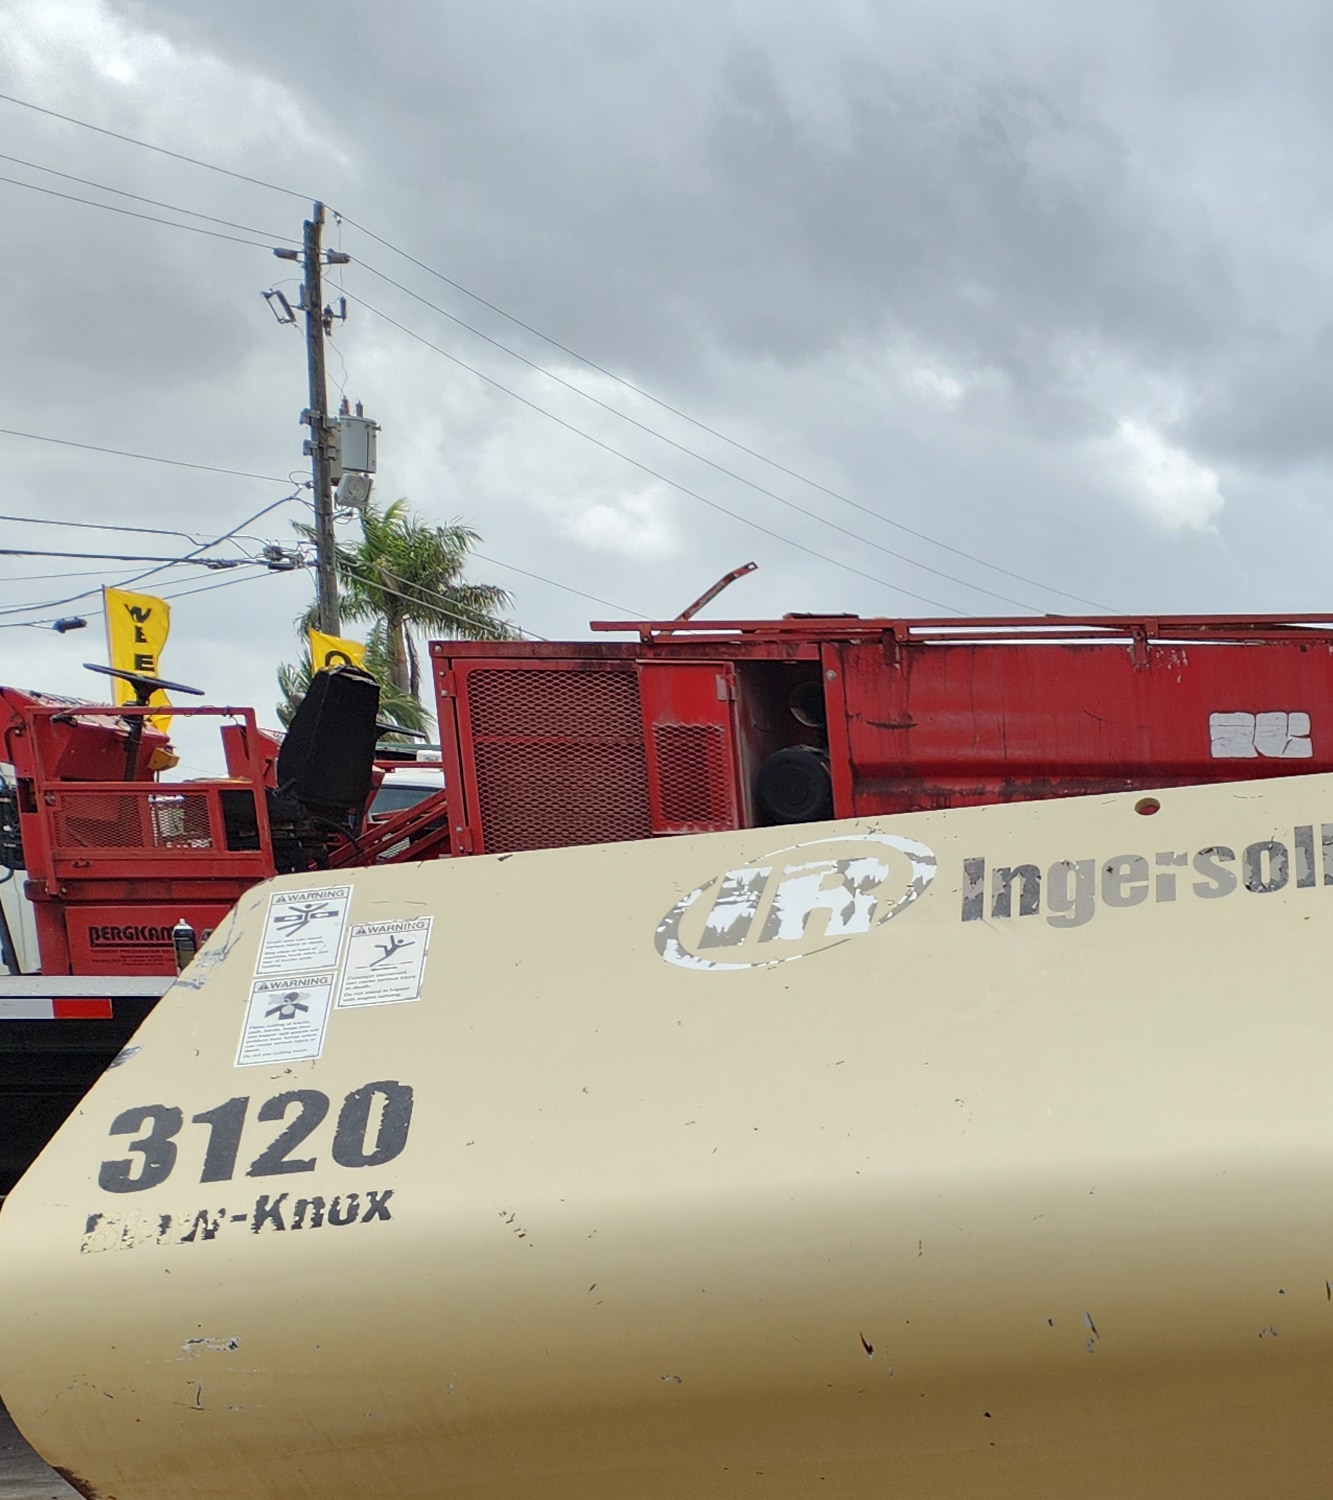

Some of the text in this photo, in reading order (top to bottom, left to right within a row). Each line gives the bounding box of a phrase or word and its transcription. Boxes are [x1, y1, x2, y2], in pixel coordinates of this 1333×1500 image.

[288, 889, 345, 902] WARNING
[88, 926, 175, 941] BERGKAM
[367, 921, 425, 934] WARNING
[270, 976, 328, 990] WARNING
[98, 1080, 414, 1193] 3120
